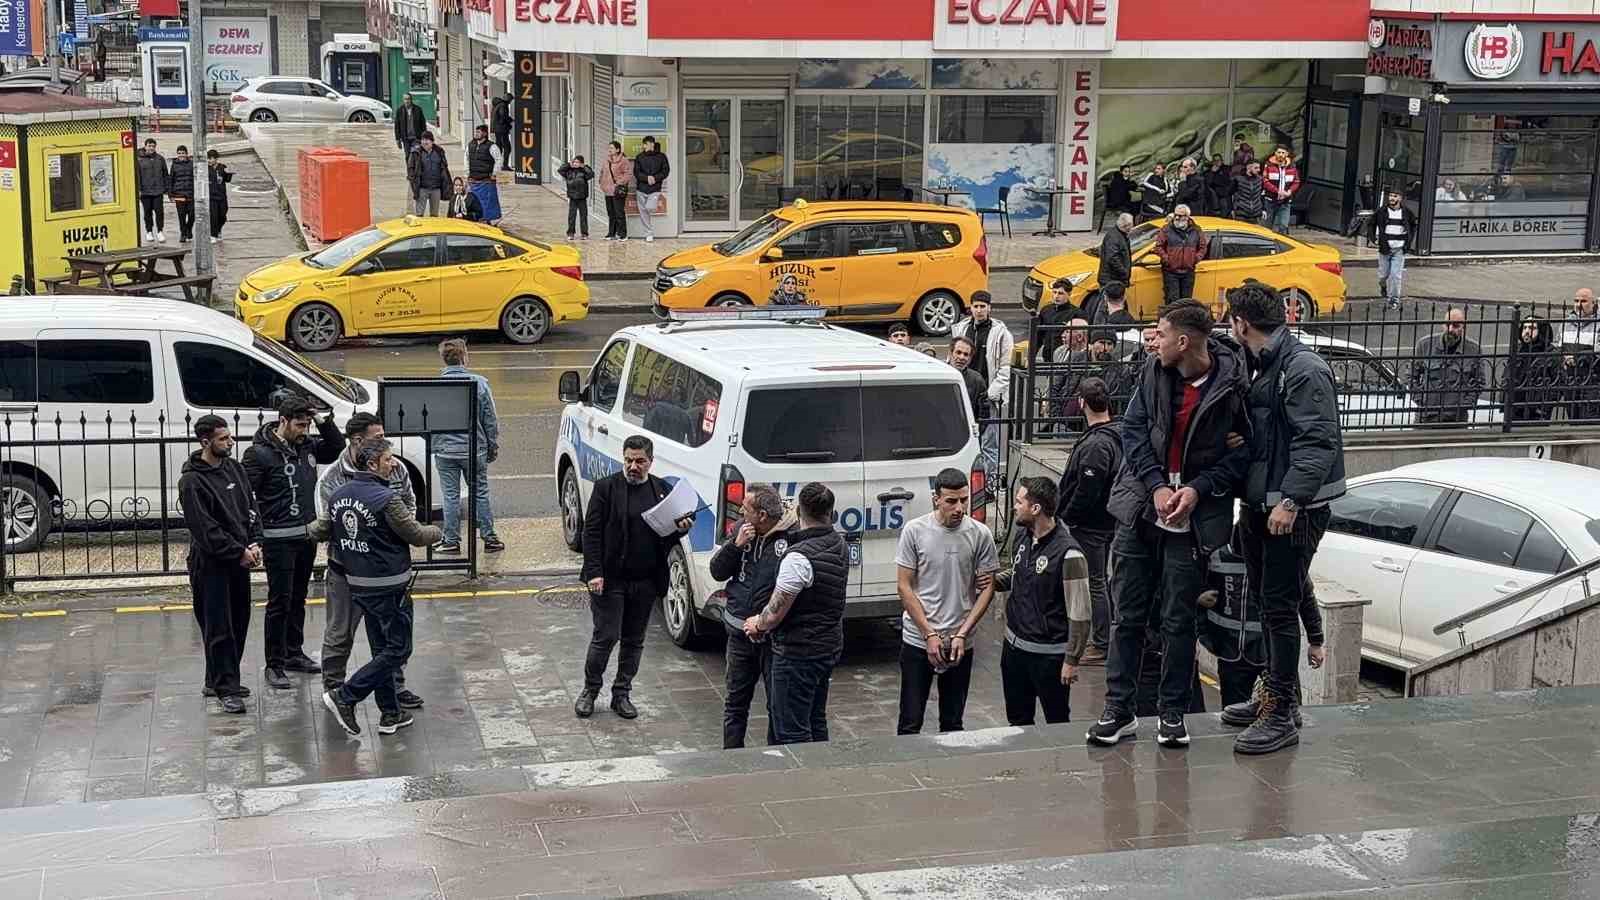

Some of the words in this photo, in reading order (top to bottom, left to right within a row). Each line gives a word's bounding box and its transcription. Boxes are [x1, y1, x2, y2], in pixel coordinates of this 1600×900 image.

[515, 0, 637, 26] ECZANE
[947, 0, 1107, 25] ECZANE
[219, 28, 250, 38] DEVA
[207, 43, 263, 55] ECZANESİ
[1480, 36, 1508, 58] HB
[1540, 31, 1600, 74] HA
[211, 69, 240, 81] SGK
[1070, 71, 1092, 214] ECZANE
[63, 225, 108, 244] HUZUR
[1459, 219, 1509, 233] HARİKA
[1512, 218, 1557, 232] BÖREK
[769, 264, 816, 280] HUZUR
[832, 500, 904, 531] OLİS
[340, 539, 369, 552] POLİS
